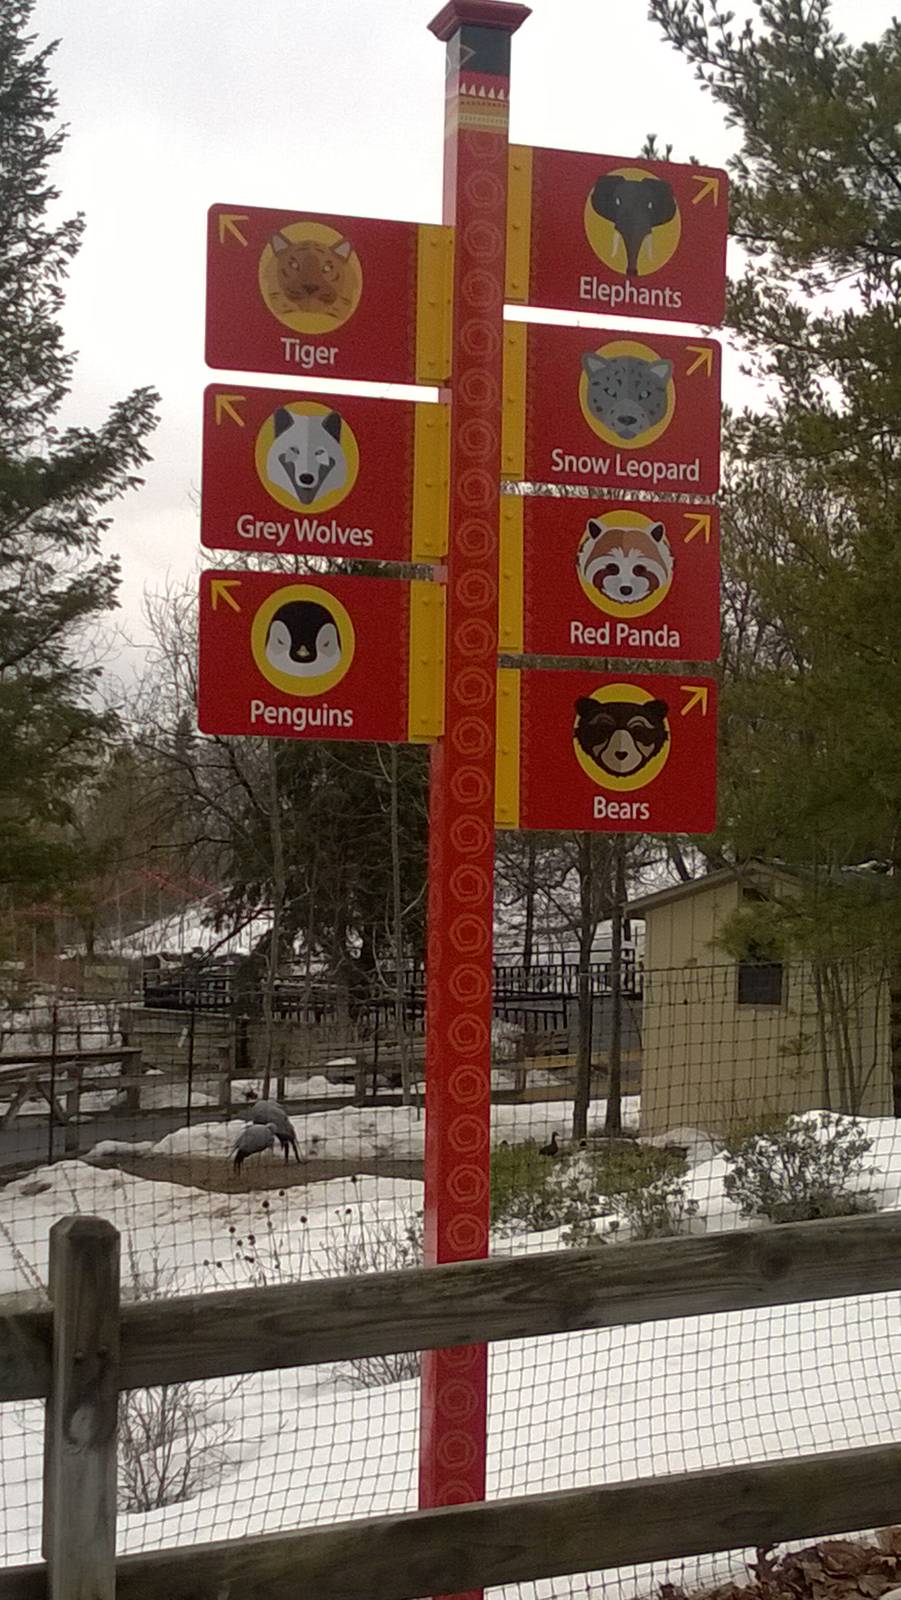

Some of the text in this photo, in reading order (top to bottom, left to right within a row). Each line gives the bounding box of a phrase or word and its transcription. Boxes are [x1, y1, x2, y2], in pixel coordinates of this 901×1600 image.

[579, 275, 683, 309] Elephants
[280, 336, 339, 369] Tiger
[550, 447, 700, 485] Snow Leopard
[236, 513, 374, 547] Grey Wolves
[569, 620, 681, 649] Red Panda
[250, 699, 354, 731] Penguins
[593, 795, 651, 821] Bears
